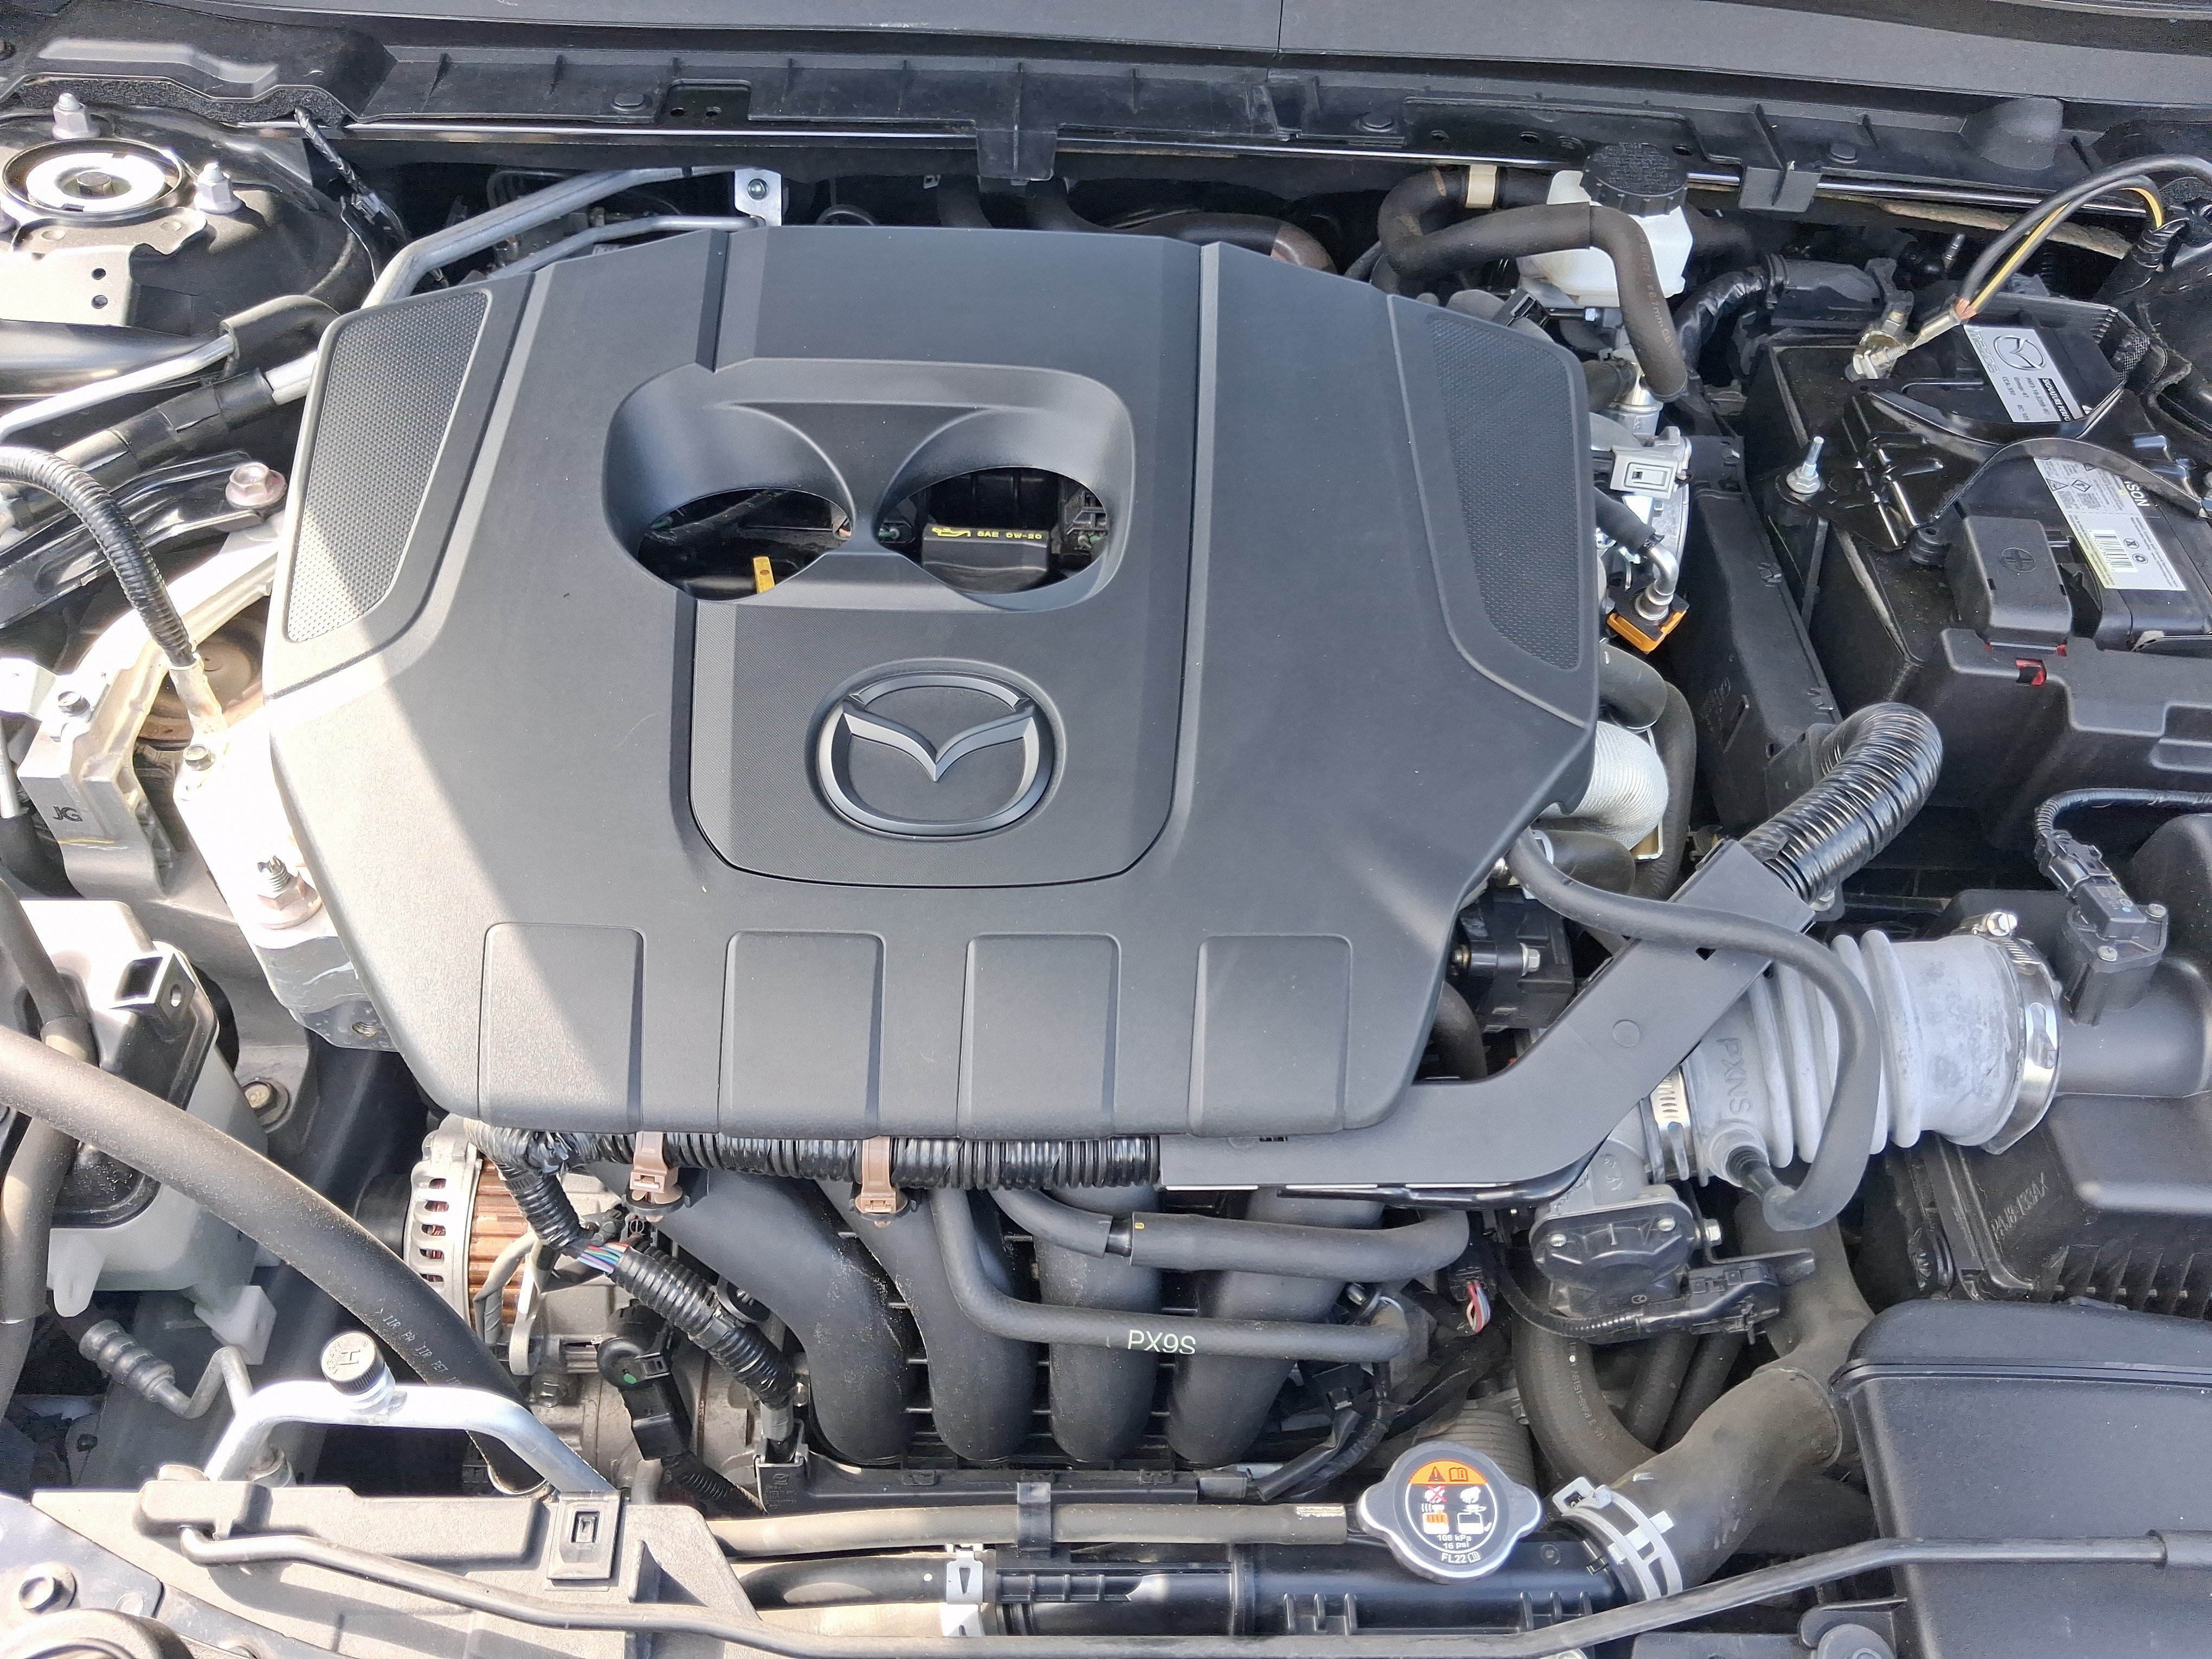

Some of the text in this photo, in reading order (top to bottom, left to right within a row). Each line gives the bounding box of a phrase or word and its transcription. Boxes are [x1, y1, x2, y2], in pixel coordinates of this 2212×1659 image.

[1716, 1038, 1751, 1114] PXNS
[1127, 1329, 1196, 1355] PX9S
[1455, 1540, 1469, 1549] psi
[1441, 1552, 1467, 1564] FL22
